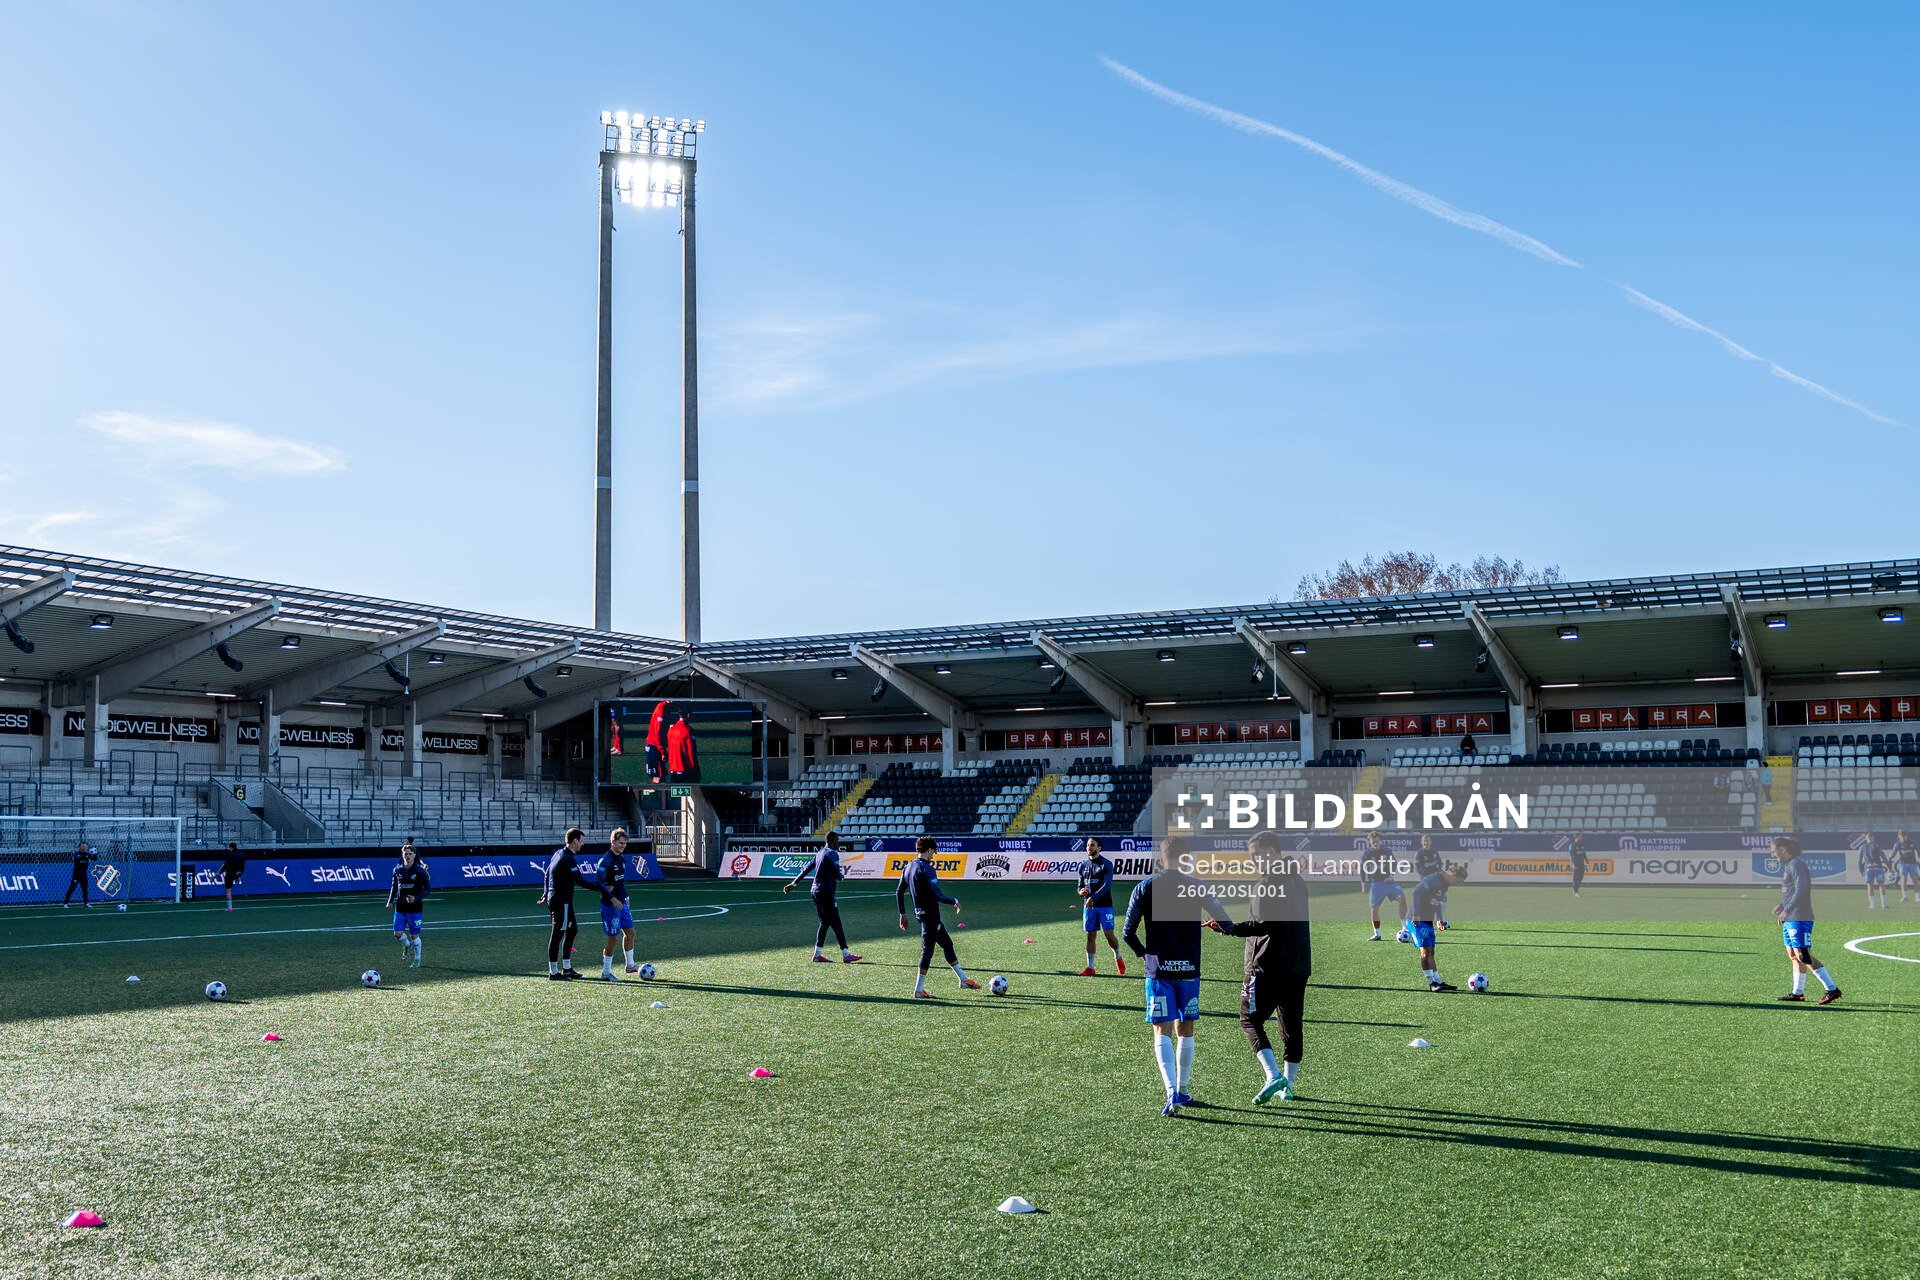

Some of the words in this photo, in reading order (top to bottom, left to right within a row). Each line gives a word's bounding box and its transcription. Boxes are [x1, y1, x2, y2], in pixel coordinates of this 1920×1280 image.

[1814, 703, 1877, 715] BRA
[1579, 712, 1636, 723] BRA
[1653, 709, 1712, 721] BRA
[1369, 720, 1418, 730] BRA
[1435, 718, 1488, 728] BRA
[1181, 726, 1226, 737] BRA
[1240, 724, 1287, 735] BRA
[381, 735, 478, 750] NORWELLNESS
[1010, 733, 1052, 743] BRA
[1064, 731, 1106, 741] BRA
[856, 739, 893, 748] BRA
[998, 840, 1033, 849] UNIBET
[1459, 837, 1503, 848] UNIBET
[462, 862, 515, 877] stadium
[891, 860, 960, 872] RARENT
[1592, 862, 1608, 872] AB
[1629, 859, 1738, 880] nearyou
[312, 866, 375, 882] stadium
